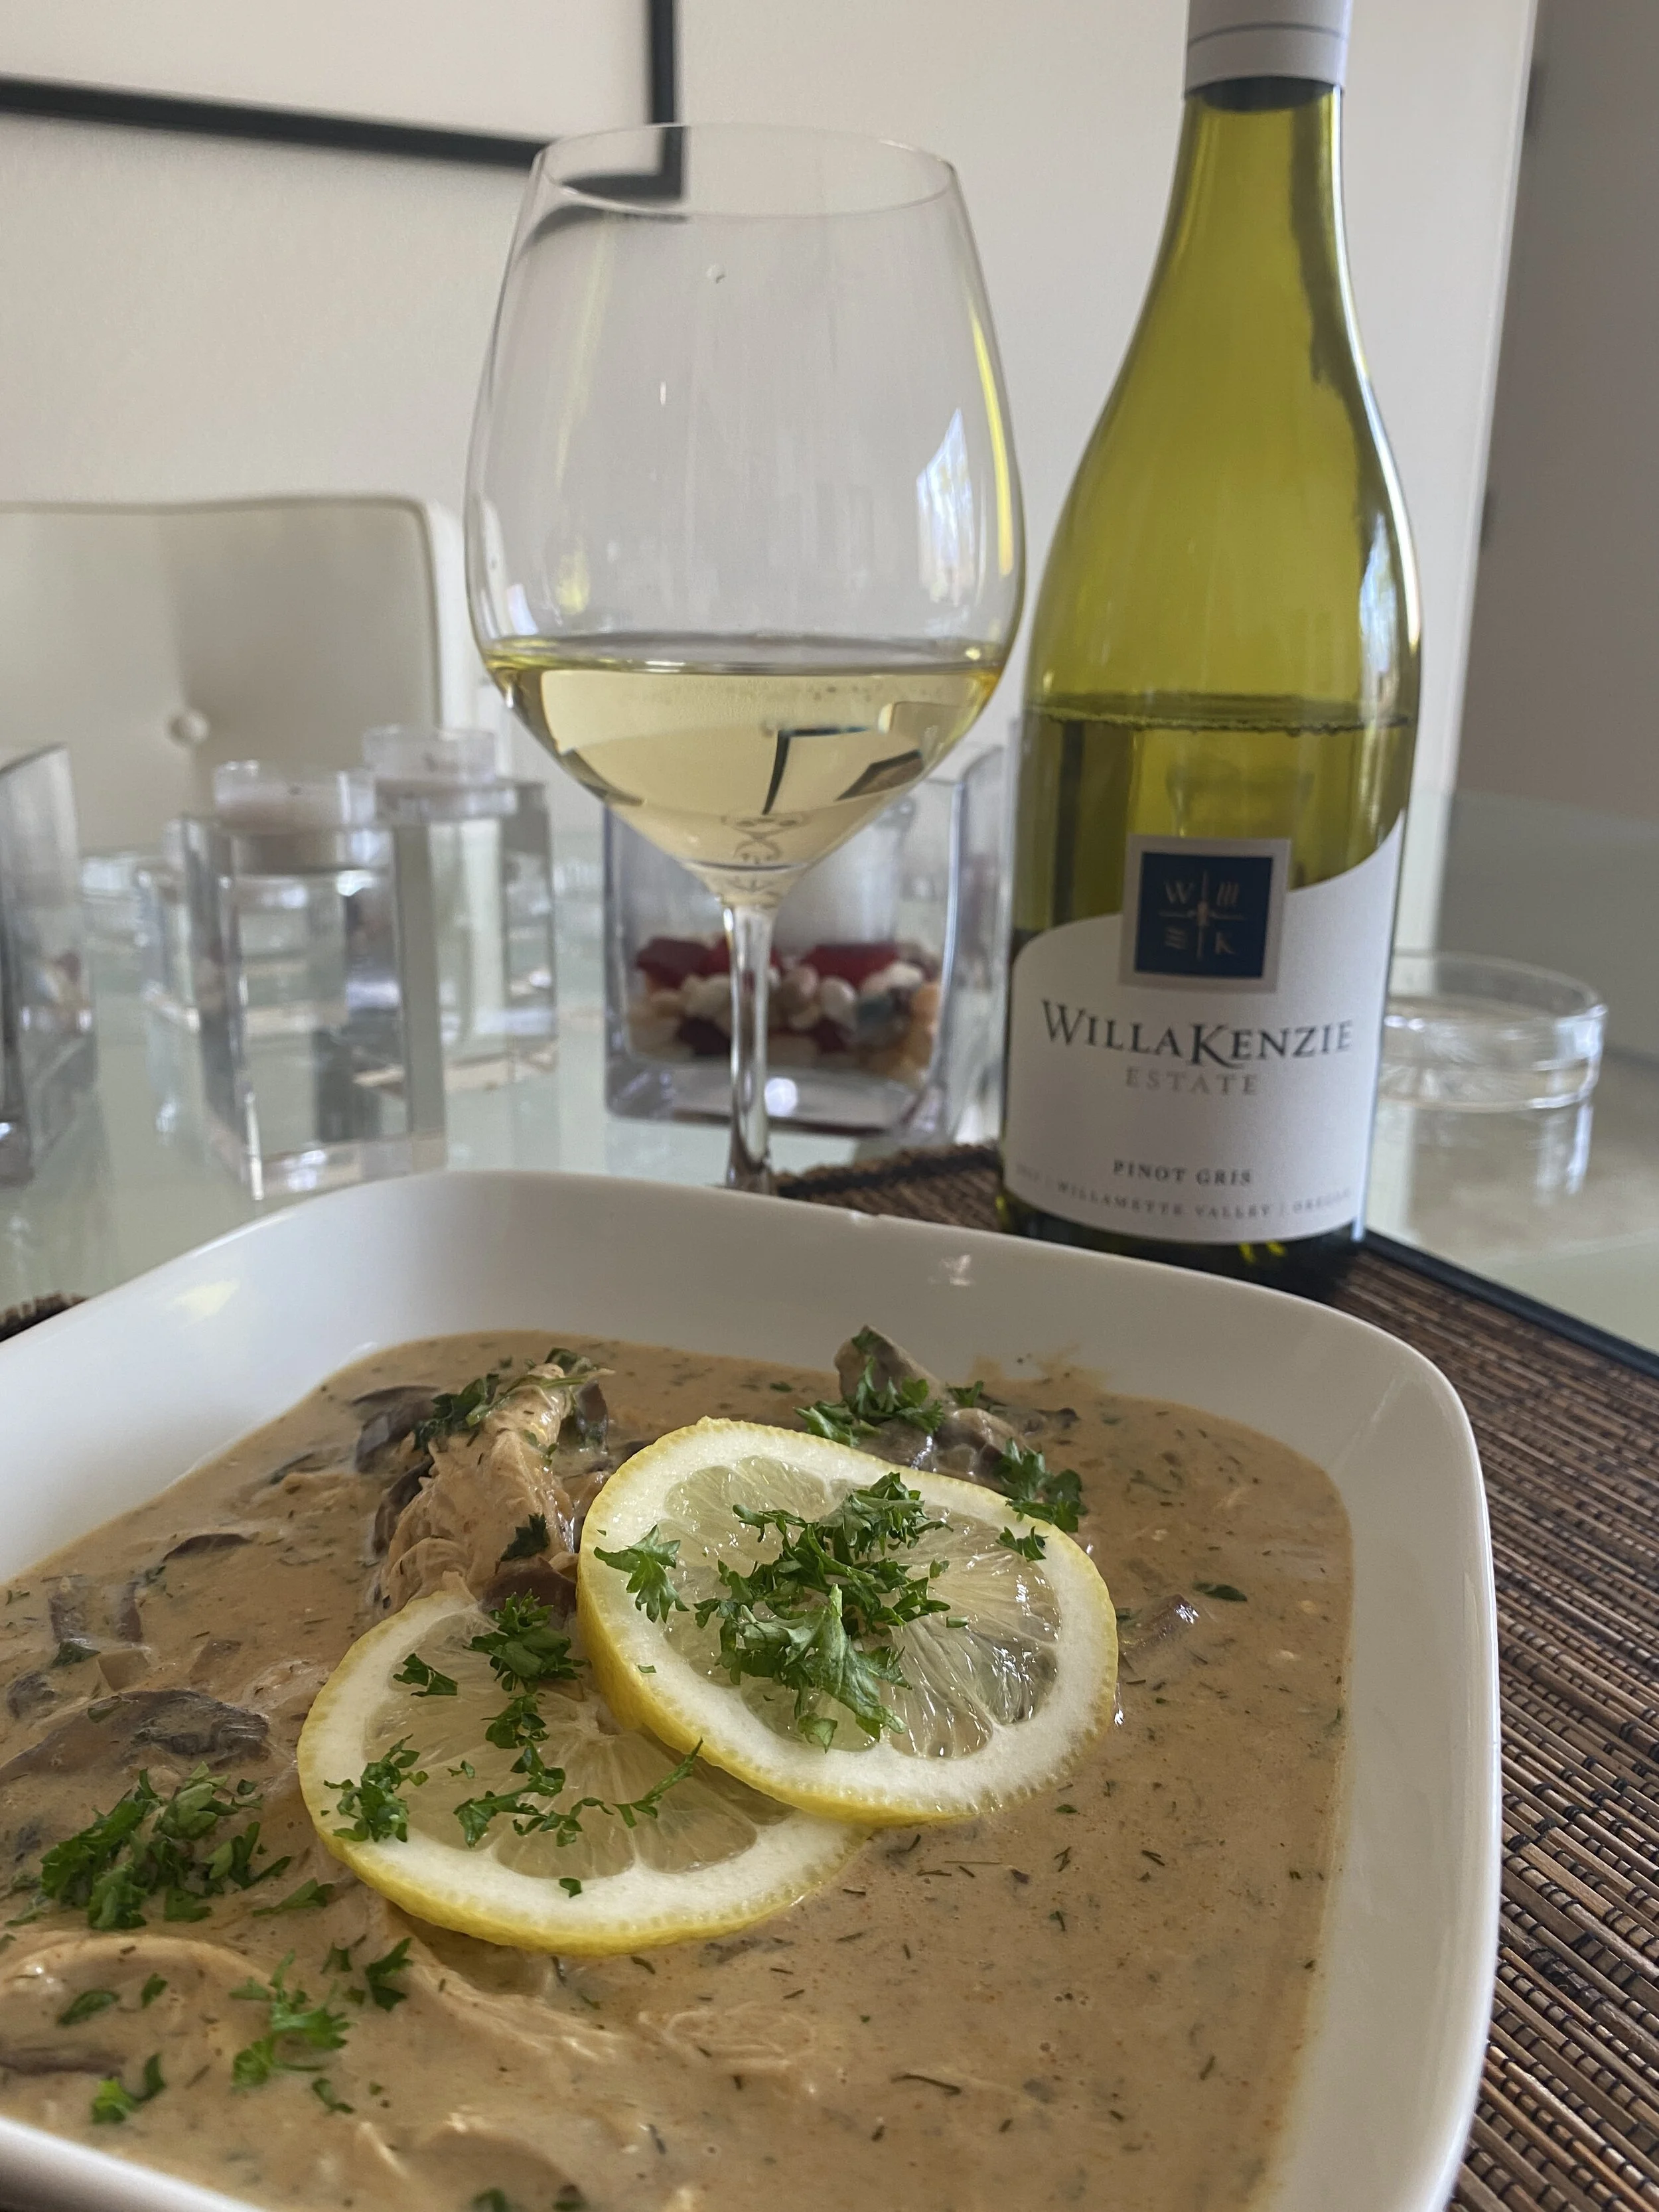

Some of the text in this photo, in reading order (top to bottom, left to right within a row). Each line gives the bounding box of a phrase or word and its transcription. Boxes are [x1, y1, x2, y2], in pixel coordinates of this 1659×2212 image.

[1041, 999, 1354, 1070] WILLAKENZIE
[1125, 1067, 1258, 1096] ESTATE
[1114, 1159, 1252, 1187] PINOT GRIS
